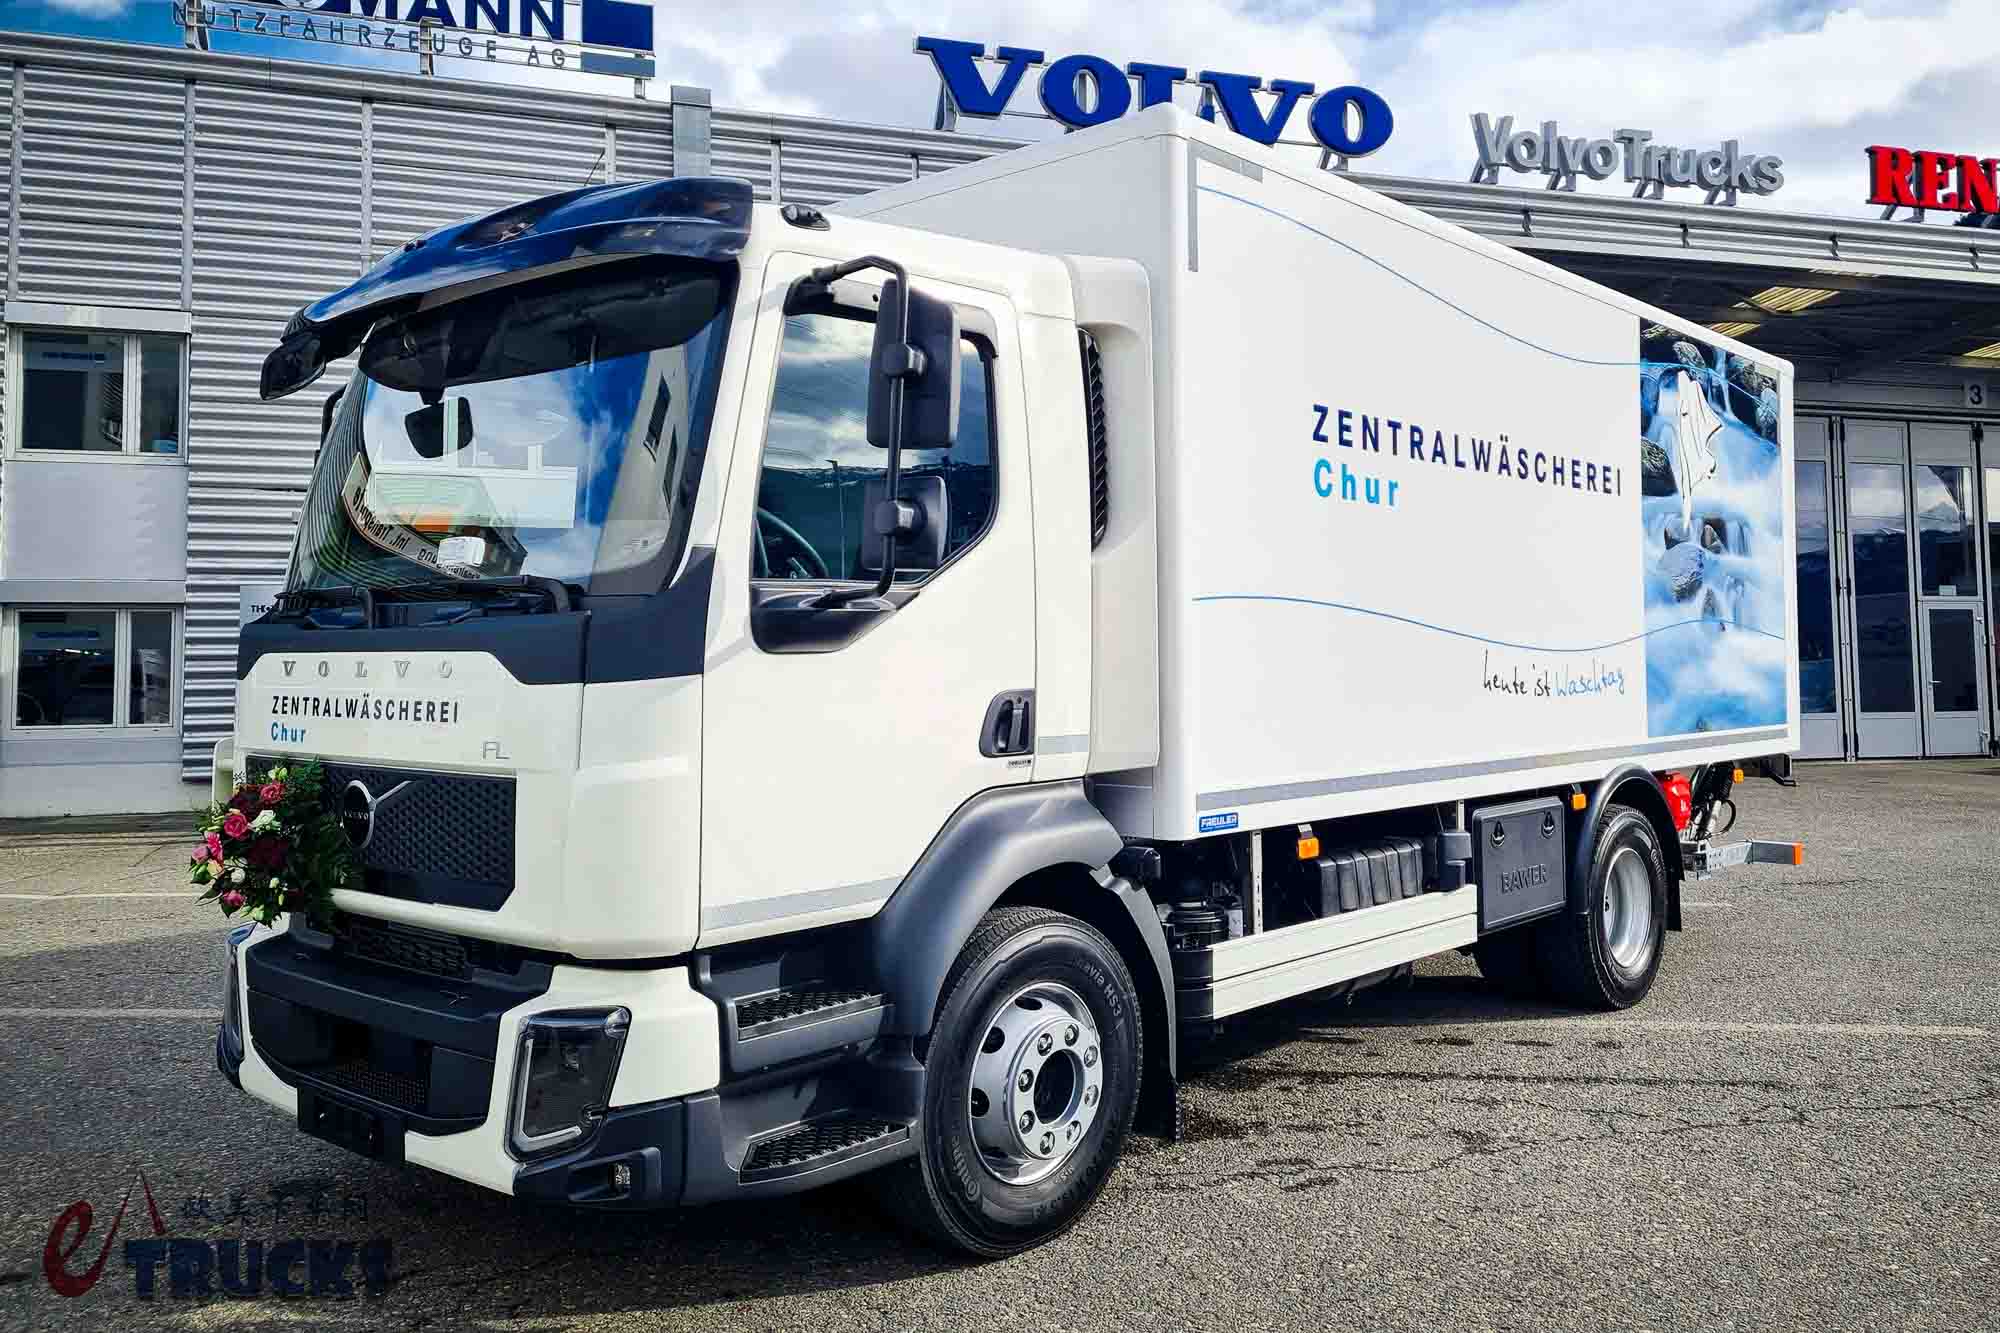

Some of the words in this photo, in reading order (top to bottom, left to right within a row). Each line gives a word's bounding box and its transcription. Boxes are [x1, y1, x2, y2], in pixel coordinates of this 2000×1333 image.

[172, 2, 498, 62] NUTZFAHRZEUGE
[527, 45, 566, 69] AG
[1969, 384, 1982, 405] 3
[1312, 403, 1622, 496] ZENTRALWÄSCHEREI
[1313, 457, 1399, 507] Chur
[282, 660, 455, 680] VOLVO
[1483, 648, 1528, 695] heute
[1531, 663, 1551, 697] ist
[1553, 656, 1625, 697] Waschtag
[271, 692, 460, 724] ZENTRALWÄSCHEREI
[270, 723, 306, 744] Chur
[1501, 863, 1547, 894] BAWER
